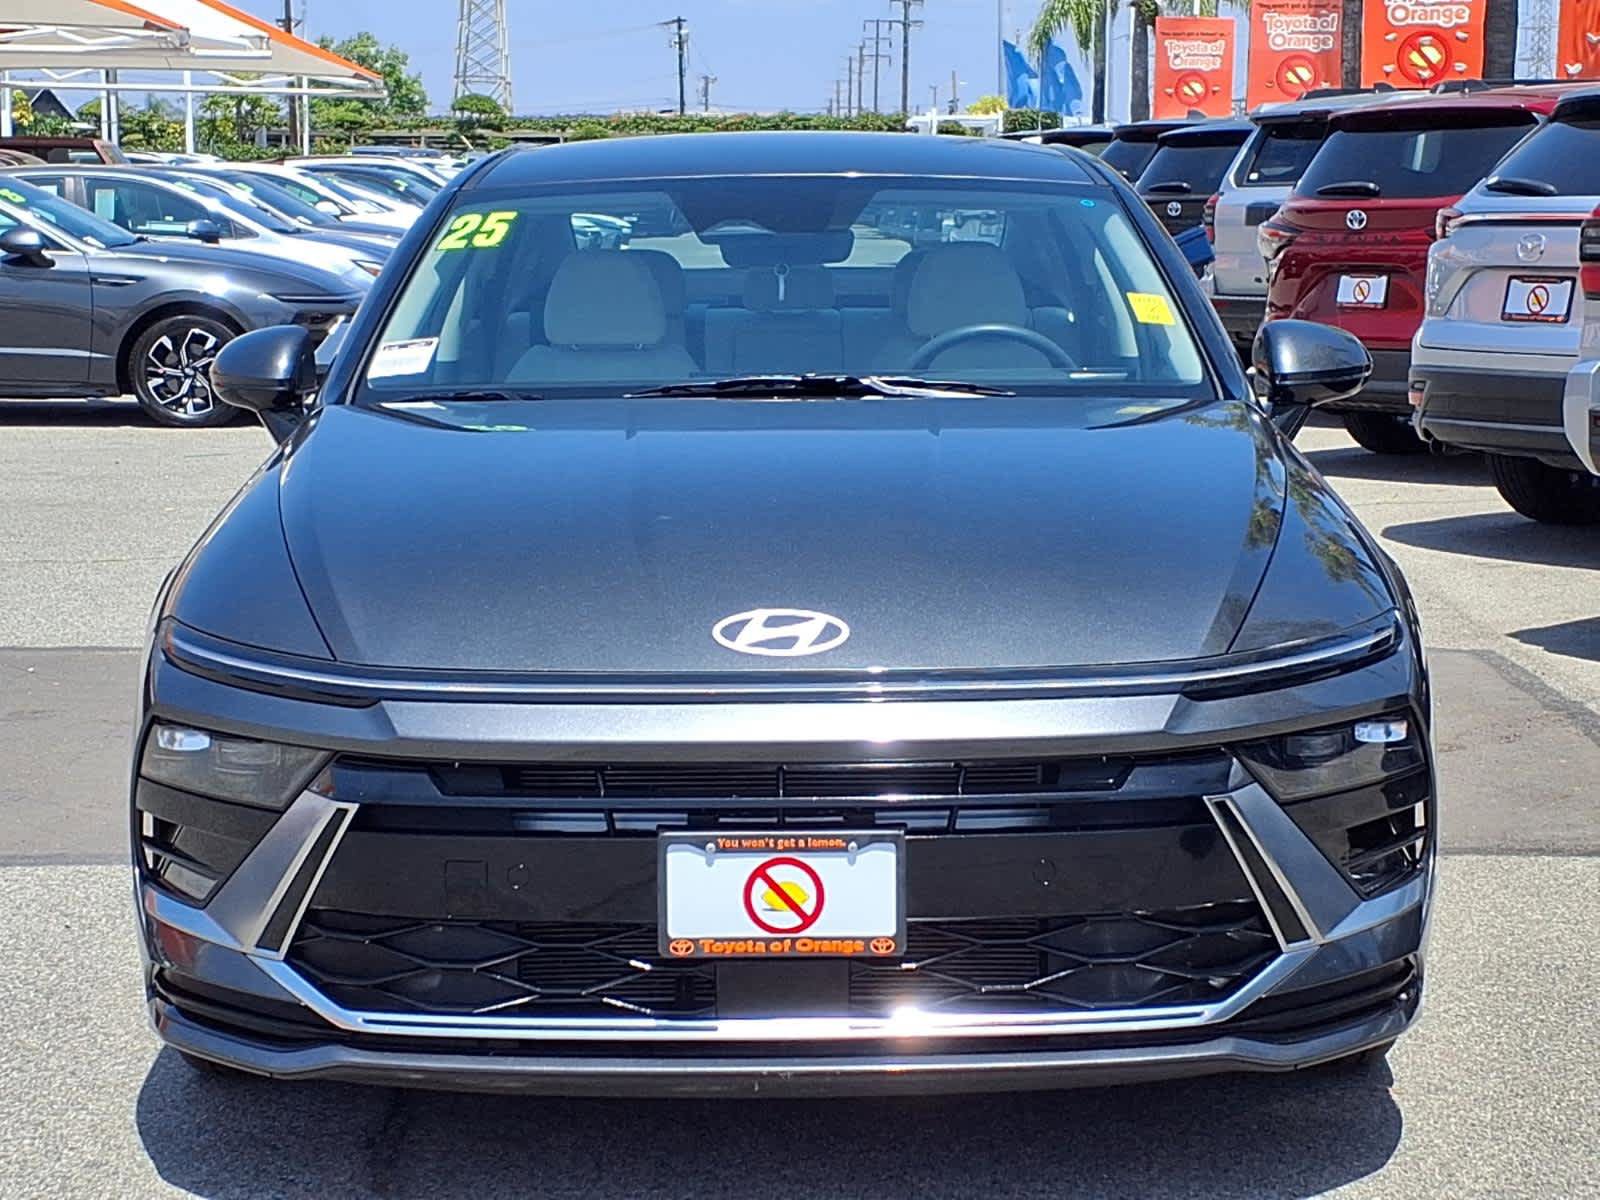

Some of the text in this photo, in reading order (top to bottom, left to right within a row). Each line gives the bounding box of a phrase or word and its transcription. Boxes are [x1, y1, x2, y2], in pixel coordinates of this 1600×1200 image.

[1263, 13, 1338, 33] Toyota of
[1389, 4, 1470, 28] Orange
[1165, 40, 1209, 55] Toyota
[1269, 32, 1334, 52] Orange
[1169, 54, 1222, 71] Orange
[438, 210, 518, 250] 25
[717, 838, 738, 849] You
[742, 838, 774, 849] won't
[777, 838, 795, 850] get
[798, 839, 805, 848] a
[699, 938, 865, 955] Toyota of Orange
